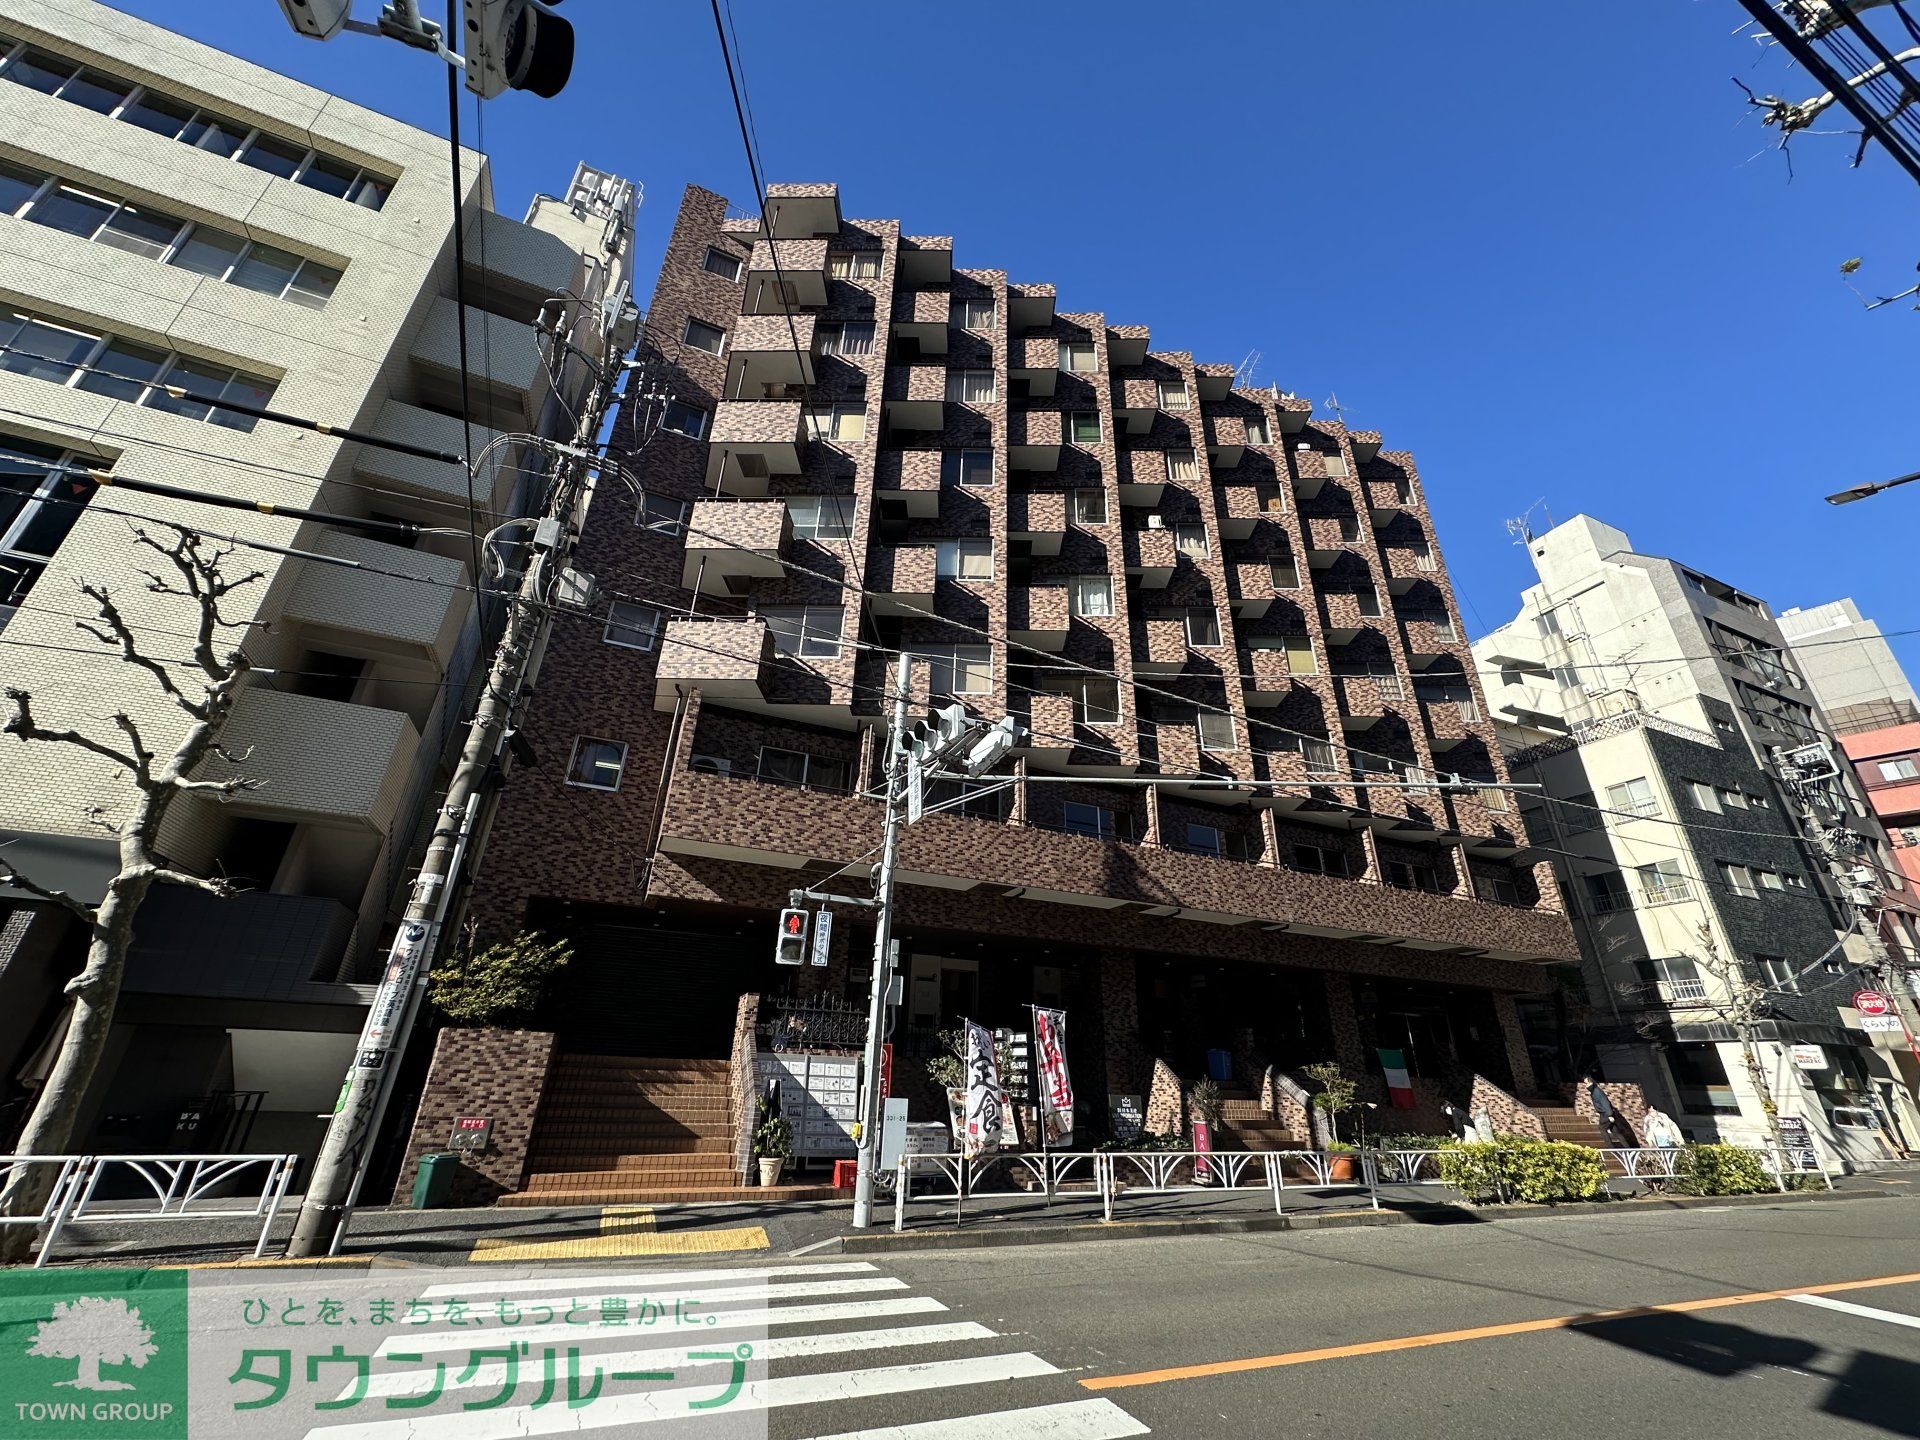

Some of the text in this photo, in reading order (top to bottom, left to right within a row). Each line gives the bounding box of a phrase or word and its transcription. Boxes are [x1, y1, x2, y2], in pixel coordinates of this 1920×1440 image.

[816, 914, 829, 963] 夜間押ボタン式
